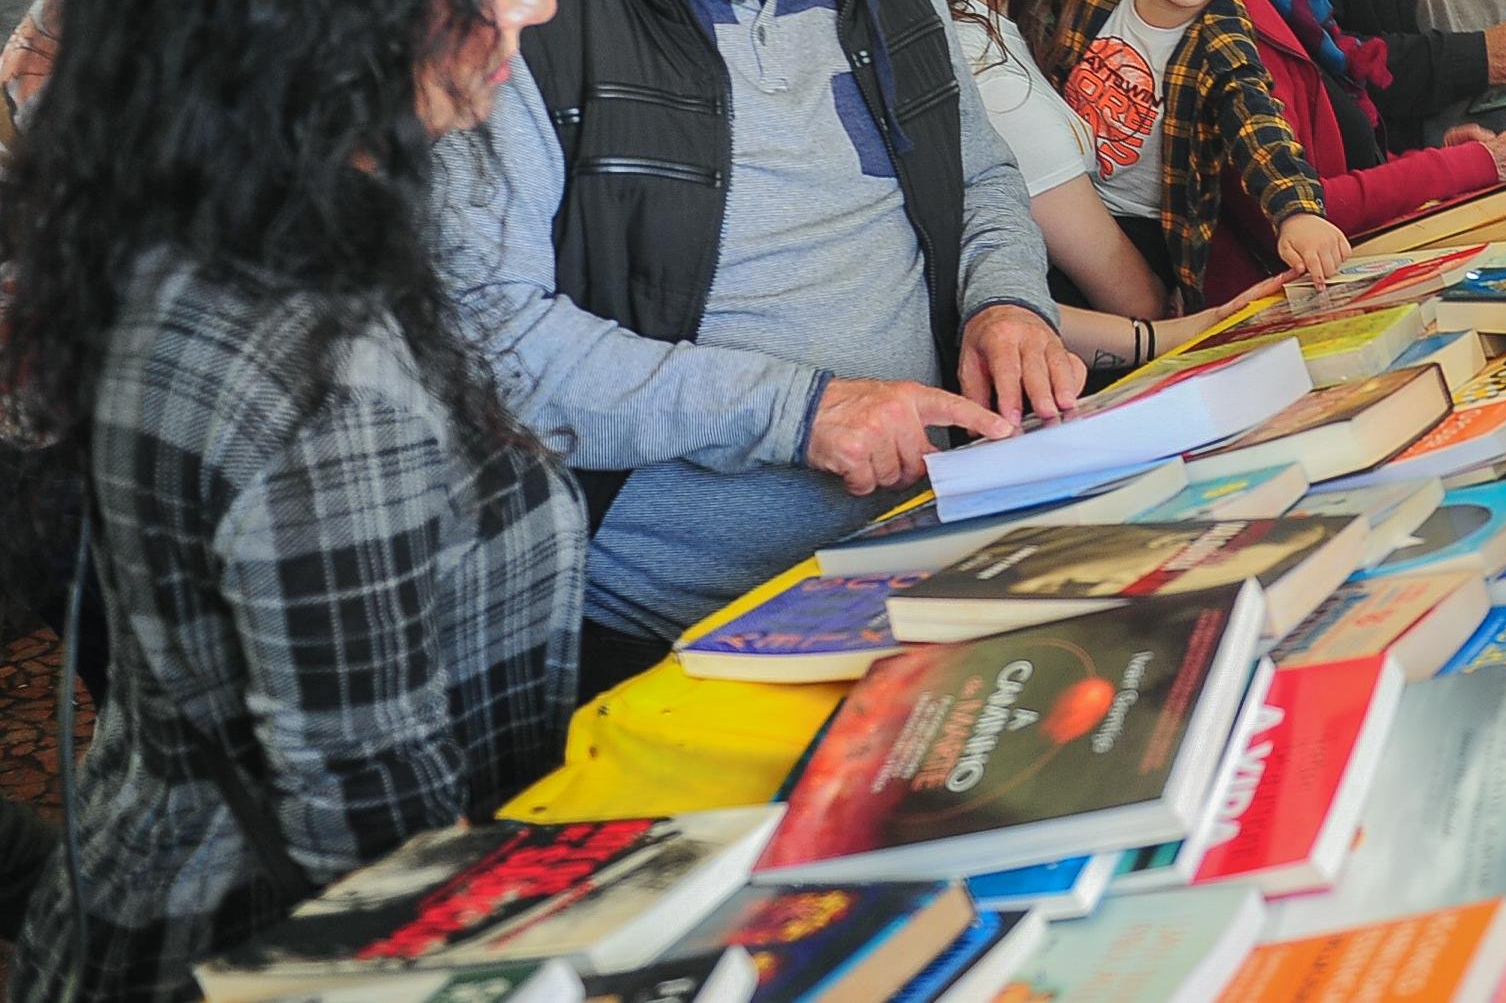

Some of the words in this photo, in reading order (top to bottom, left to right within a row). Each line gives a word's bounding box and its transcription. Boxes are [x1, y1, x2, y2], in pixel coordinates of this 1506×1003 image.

[943, 659, 1034, 795] CAMINHO
[1006, 707, 1040, 732] A
[1204, 739, 1275, 848] VIDA
